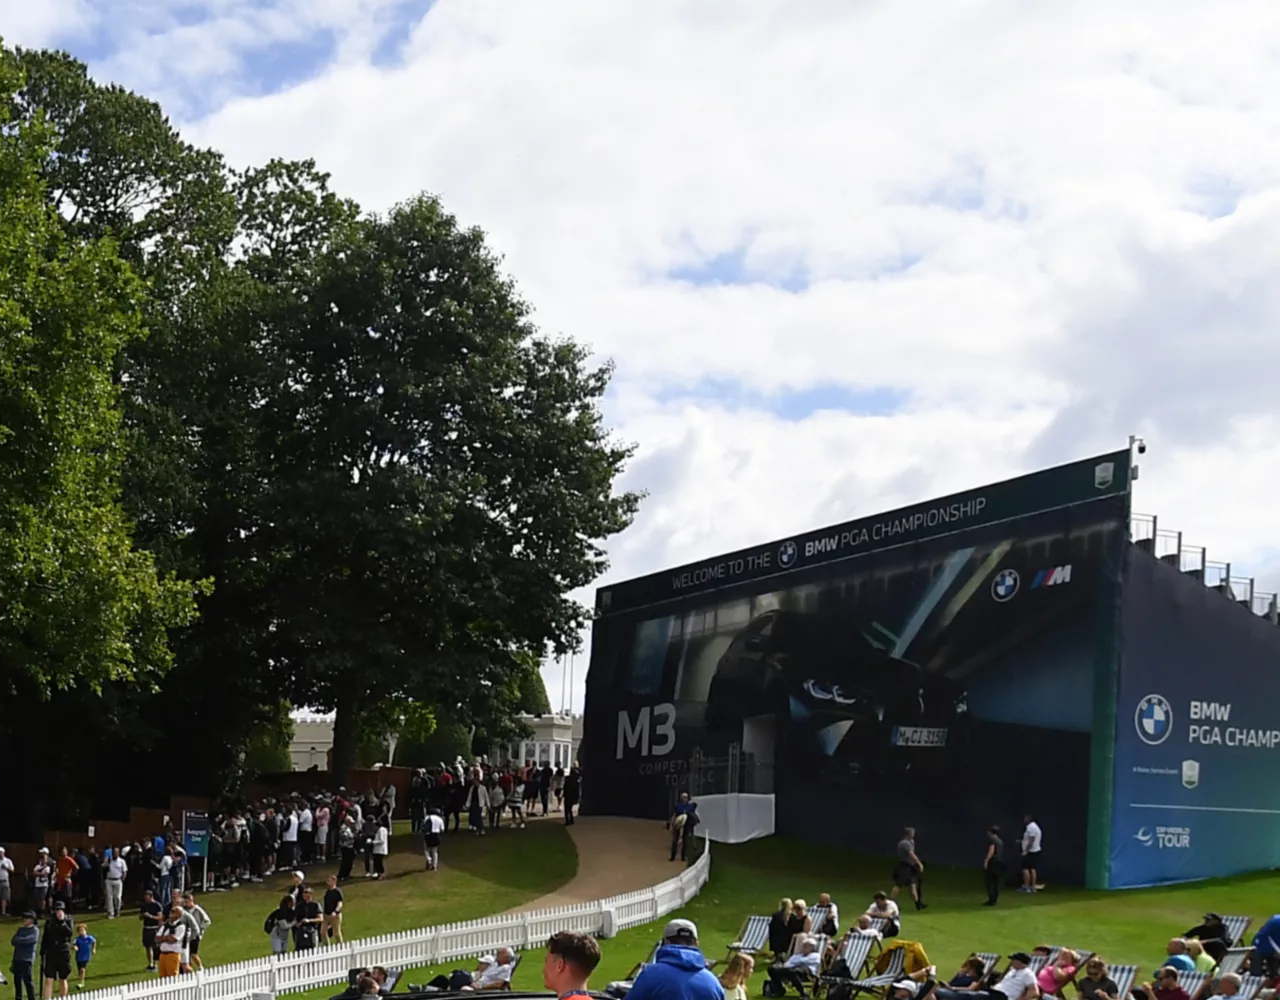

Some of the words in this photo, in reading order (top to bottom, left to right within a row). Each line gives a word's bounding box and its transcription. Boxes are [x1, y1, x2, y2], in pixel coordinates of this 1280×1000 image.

[672, 563, 725, 589] WELCOME
[728, 559, 744, 575] TO
[746, 551, 771, 570] THE
[805, 535, 839, 557] BMW
[841, 528, 869, 548] PGA
[871, 497, 987, 540] CHAMPIONSHIP
[1189, 701, 1231, 721] BMW
[616, 702, 677, 760] M3
[1189, 725, 1221, 745] PGA
[1225, 727, 1280, 748] CHAMP
[1157, 834, 1190, 848] TOUR
